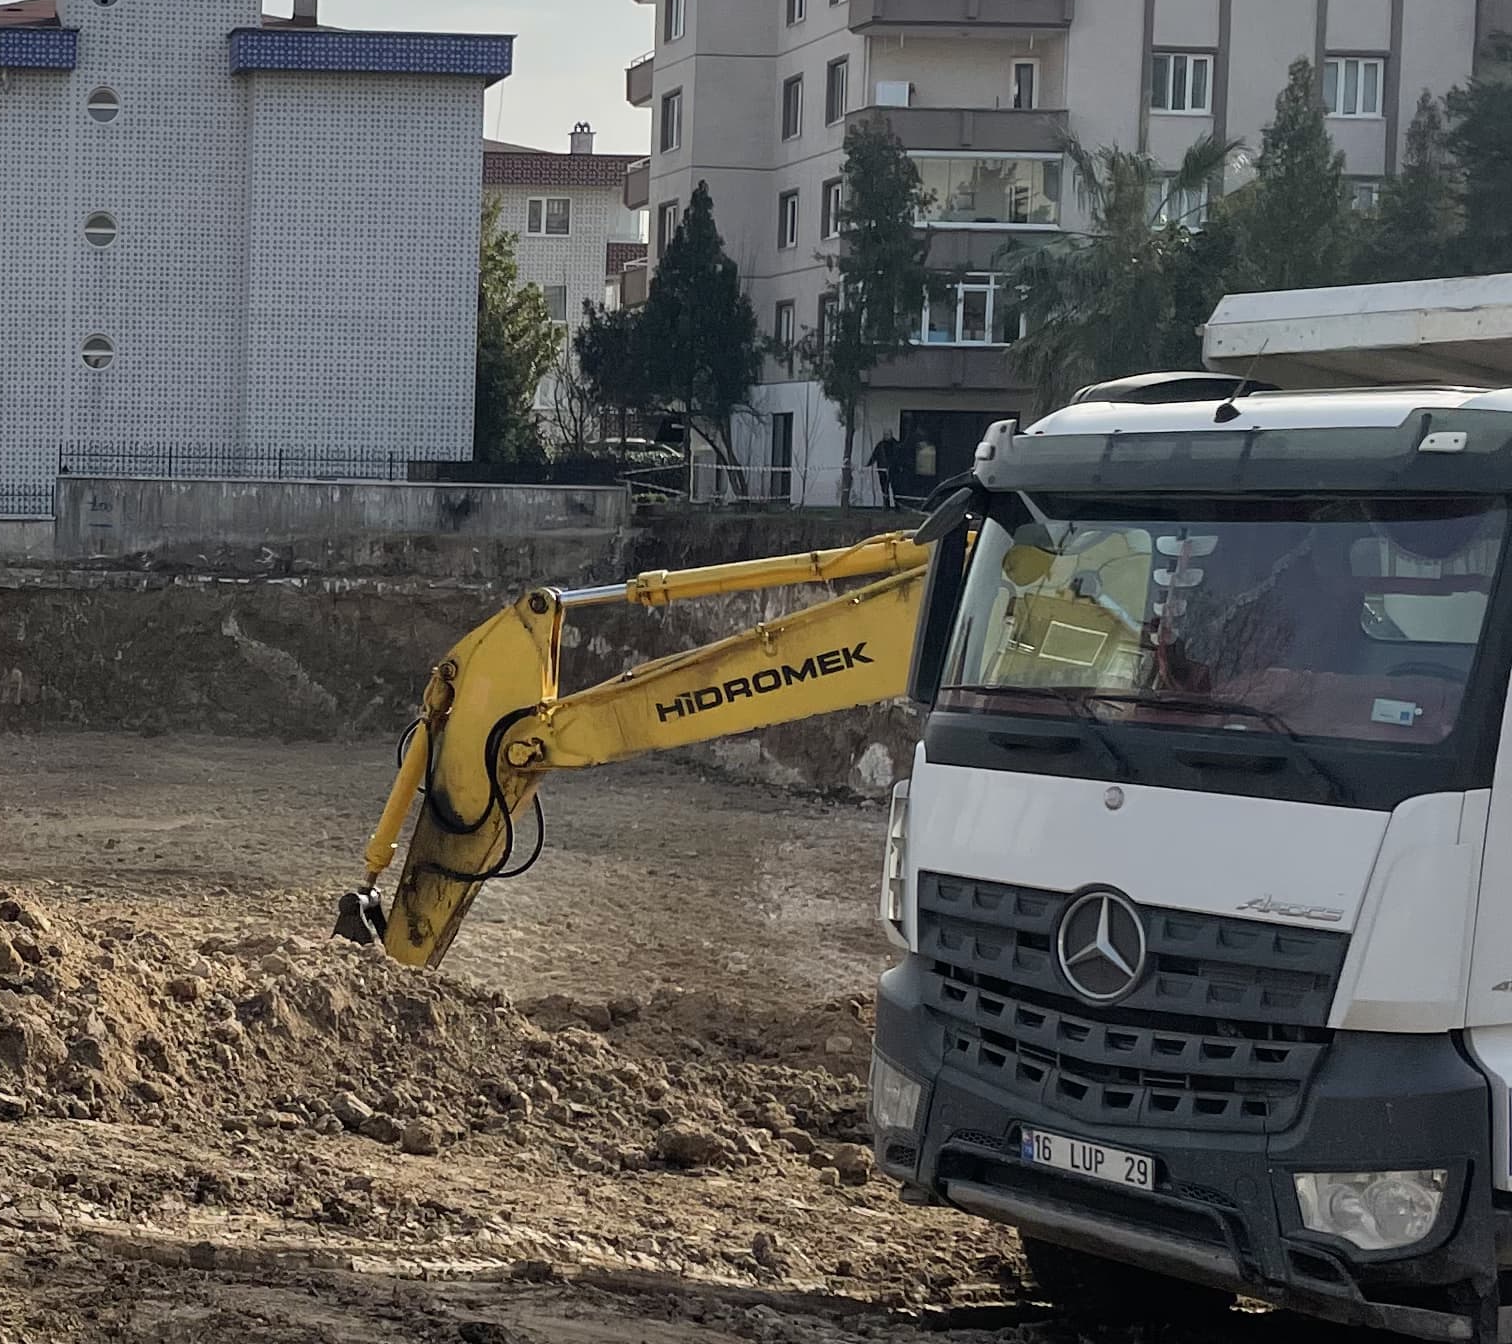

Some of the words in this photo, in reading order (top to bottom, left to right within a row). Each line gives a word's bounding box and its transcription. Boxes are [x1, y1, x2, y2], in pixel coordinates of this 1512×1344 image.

[1035, 1134, 1052, 1161] 16
[1070, 1143, 1105, 1173] LUP
[1124, 1156, 1148, 1185] 29
